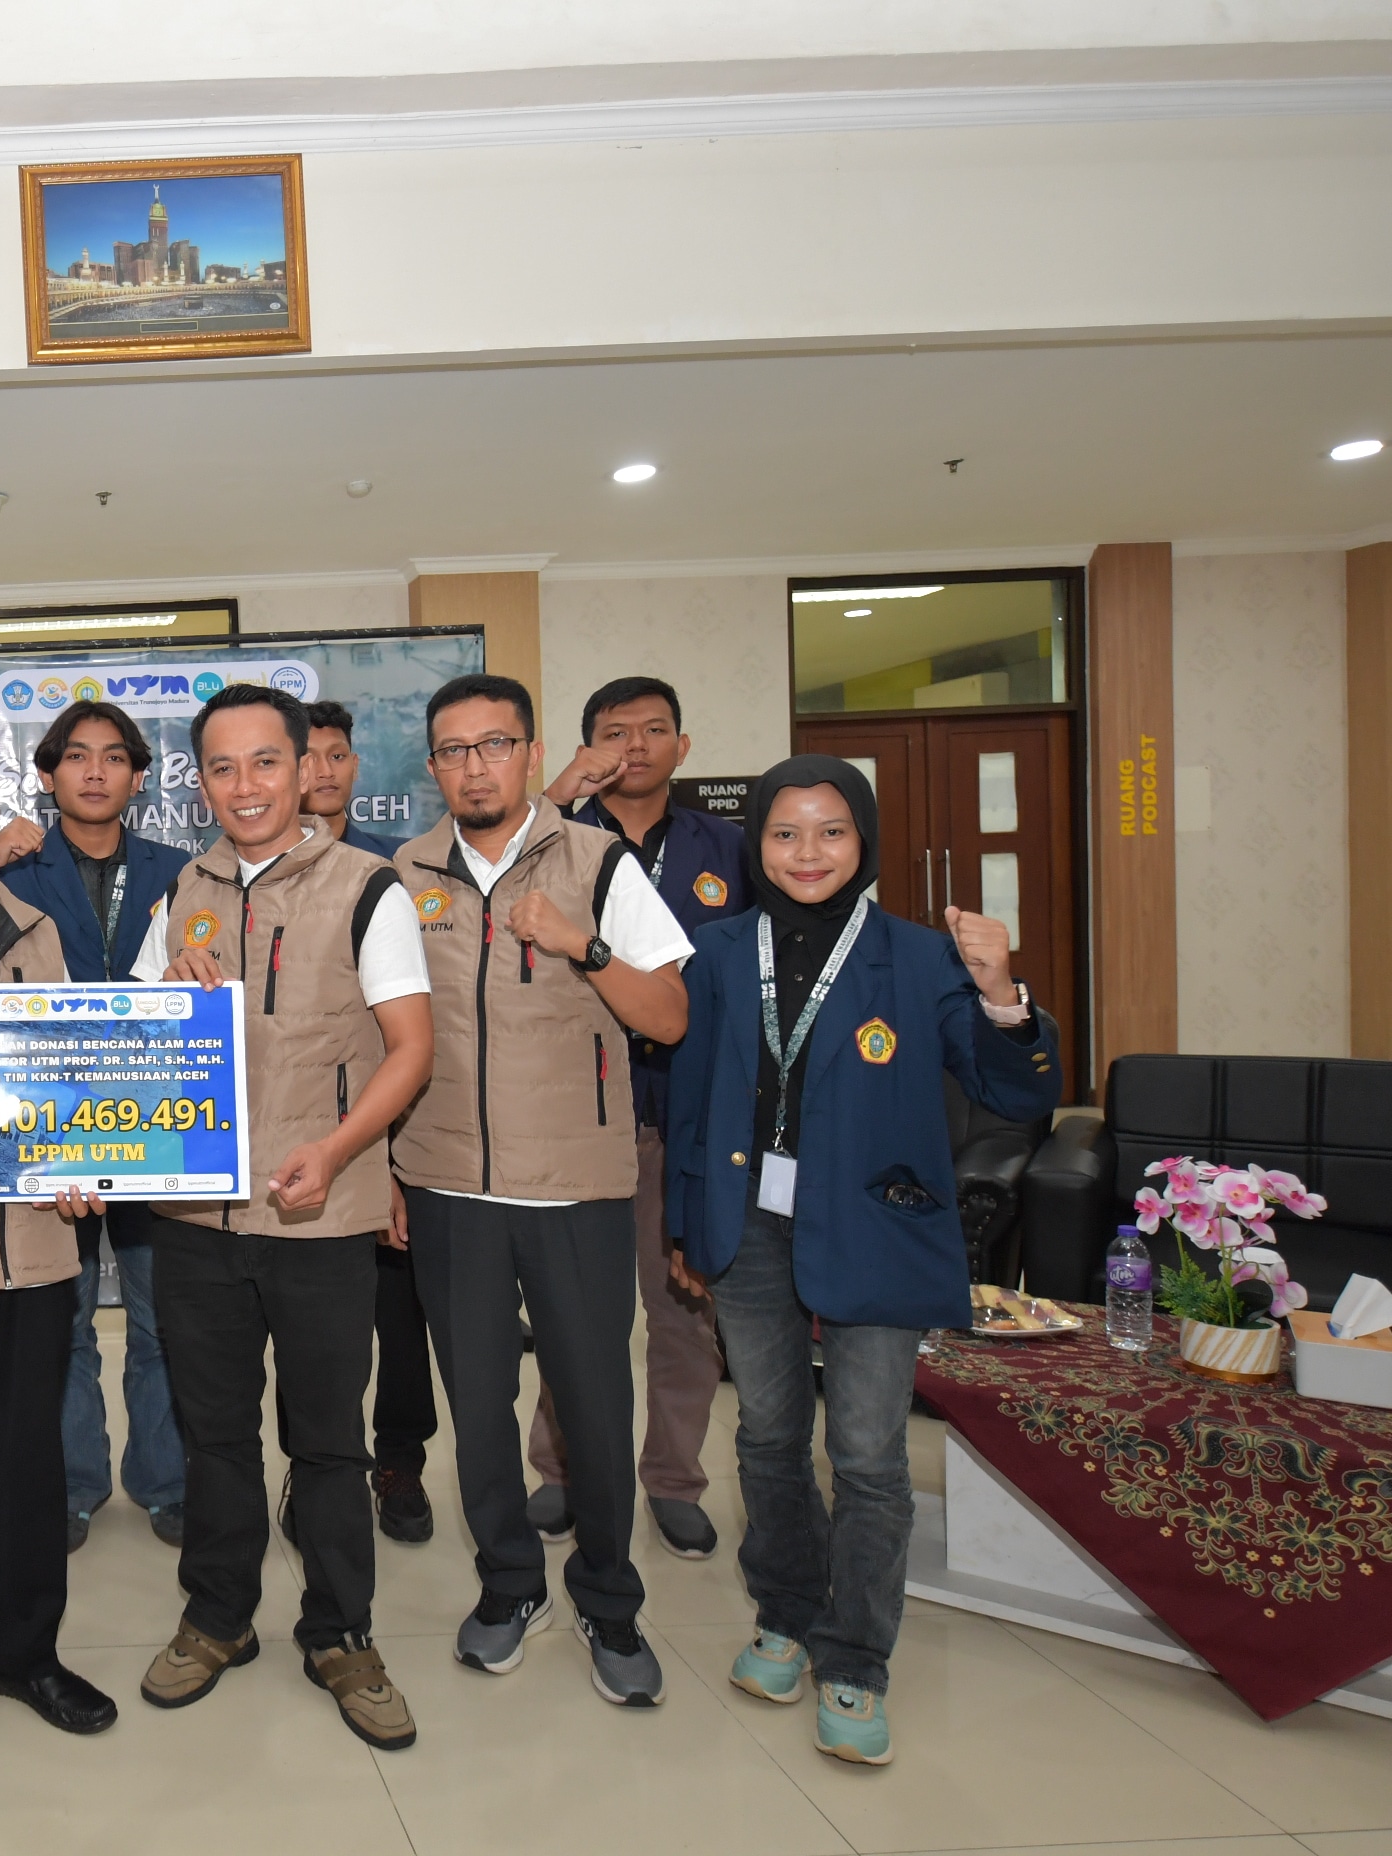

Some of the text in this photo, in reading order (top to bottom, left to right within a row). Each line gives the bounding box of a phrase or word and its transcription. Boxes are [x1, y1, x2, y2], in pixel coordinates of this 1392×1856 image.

[273, 679, 302, 689] LPPM
[698, 784, 748, 797] RUANG
[1140, 733, 1158, 835] PODCAST
[1118, 759, 1136, 836] RUANG
[347, 794, 411, 822] CEH
[708, 798, 740, 811] PPID
[430, 922, 454, 932] UTM
[30, 1040, 79, 1050] DONASI
[82, 1039, 145, 1050] BENCANA
[148, 1039, 184, 1049] ALAM
[187, 1039, 222, 1049] ACEH
[31, 1056, 60, 1066] UTM
[63, 1056, 99, 1066] PROF.
[103, 1056, 124, 1066] DR.
[128, 1055, 161, 1067] SAFI,
[164, 1055, 193, 1067] S.H.,
[197, 1055, 225, 1065] M.H.
[4, 1072, 29, 1083] TIM
[31, 1072, 71, 1083] KKN-T
[74, 1071, 170, 1082] KEMANUSIAAN
[174, 1071, 209, 1081] ACEH
[18, 1143, 146, 1162] LPPM UTM
